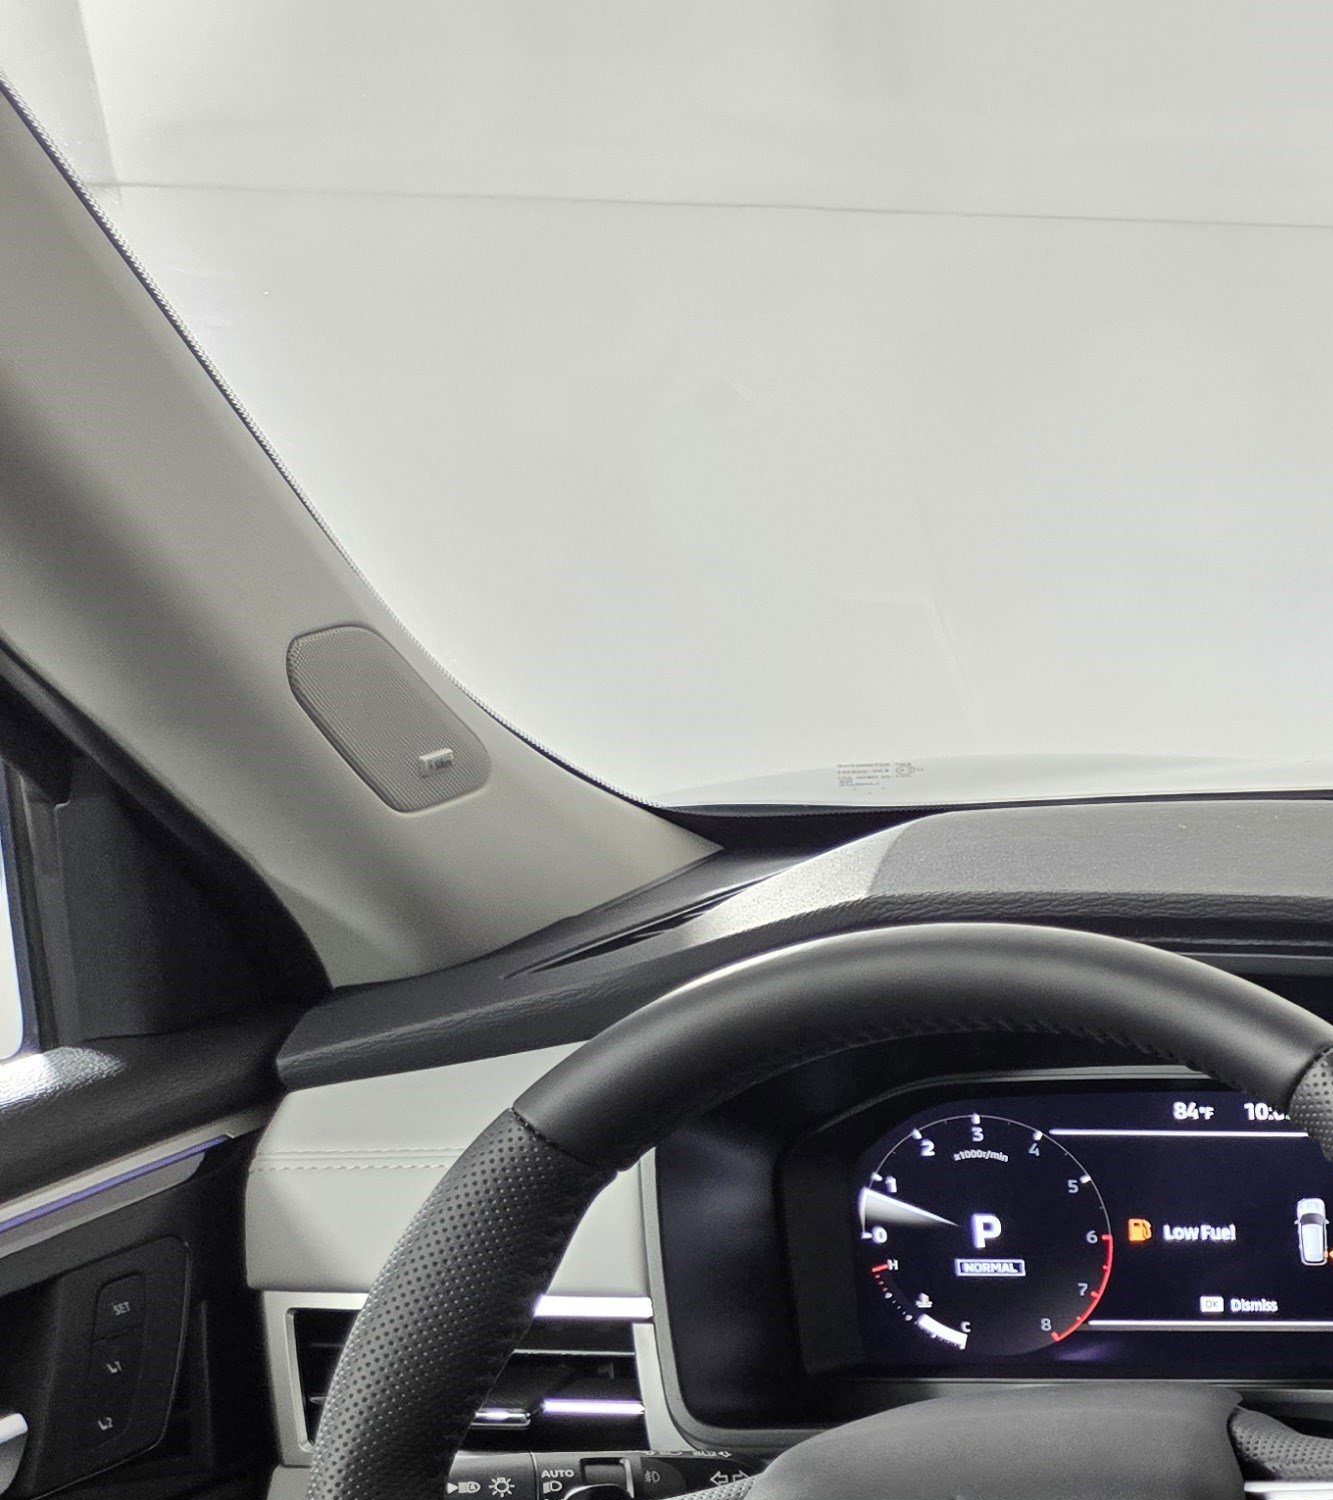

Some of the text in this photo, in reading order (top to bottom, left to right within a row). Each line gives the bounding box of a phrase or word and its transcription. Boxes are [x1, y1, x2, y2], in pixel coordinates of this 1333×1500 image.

[970, 1126, 984, 1142] 3
[920, 1139, 936, 1157] 2
[1028, 1142, 1040, 1157] 4
[885, 1175, 898, 1193] 1
[1067, 1179, 1079, 1194] 5
[871, 1225, 888, 1245] 0
[970, 1213, 1002, 1249] P
[1086, 1231, 1099, 1245] 6
[1162, 1223, 1237, 1242] Low Fuel
[887, 1258, 899, 1271] H
[961, 1261, 1019, 1275] NORMAL
[1077, 1283, 1089, 1297] 7
[112, 1301, 131, 1316] SET
[1205, 1297, 1279, 1313] OK Dismiss
[960, 1321, 972, 1334] C
[1040, 1317, 1052, 1332] 8
[541, 1469, 574, 1479] AUTO
